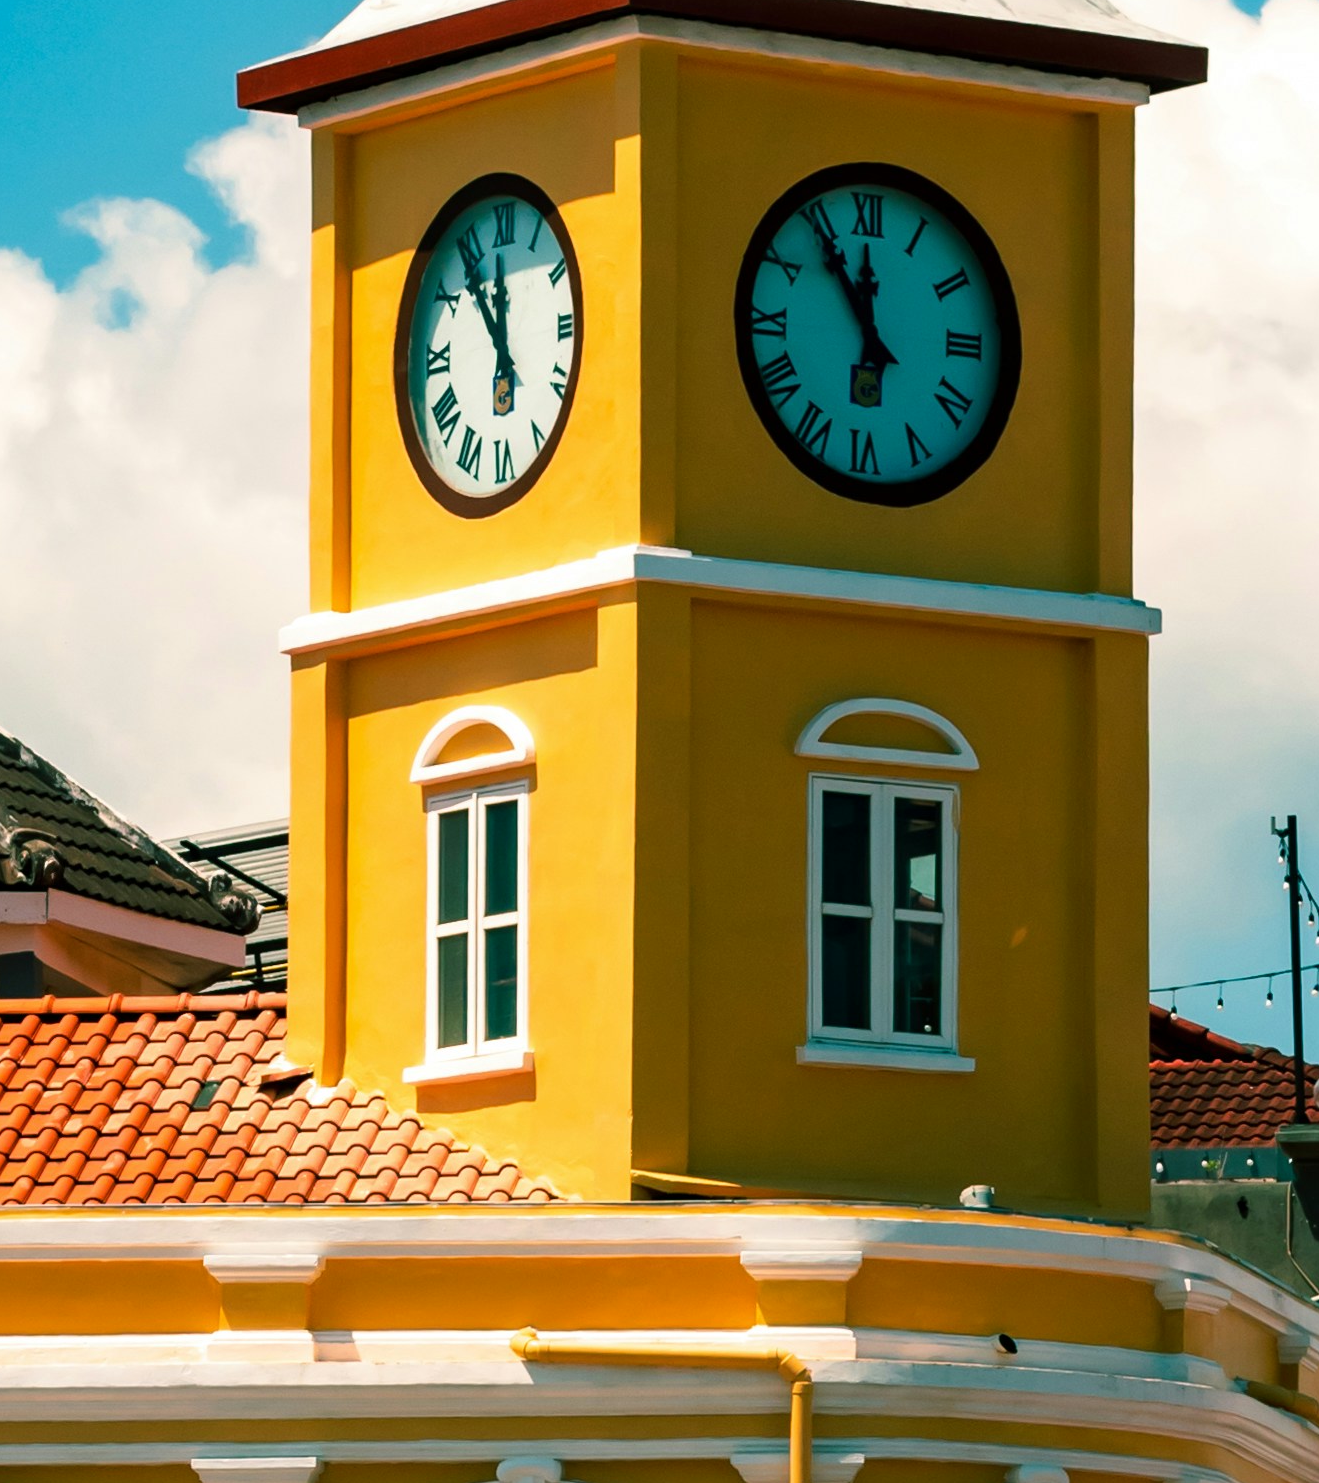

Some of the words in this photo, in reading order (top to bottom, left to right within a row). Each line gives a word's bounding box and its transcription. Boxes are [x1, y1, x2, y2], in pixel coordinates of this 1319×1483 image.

[493, 201, 517, 248] XII
[528, 217, 543, 252] I
[850, 192, 885, 239] XII
[904, 215, 929, 258] I
[762, 238, 803, 287] X
[933, 267, 970, 302] II
[434, 278, 461, 318] X
[558, 313, 573, 342] III
[752, 303, 787, 341] IX
[946, 328, 982, 362] III
[427, 341, 451, 379] IX
[762, 349, 802, 410] VIII
[432, 382, 462, 448] VIII
[933, 375, 974, 431] IV
[456, 424, 483, 481] VII
[794, 399, 833, 462] VII
[849, 428, 881, 475] VI
[905, 422, 933, 468] V
[494, 438, 517, 484] VI
